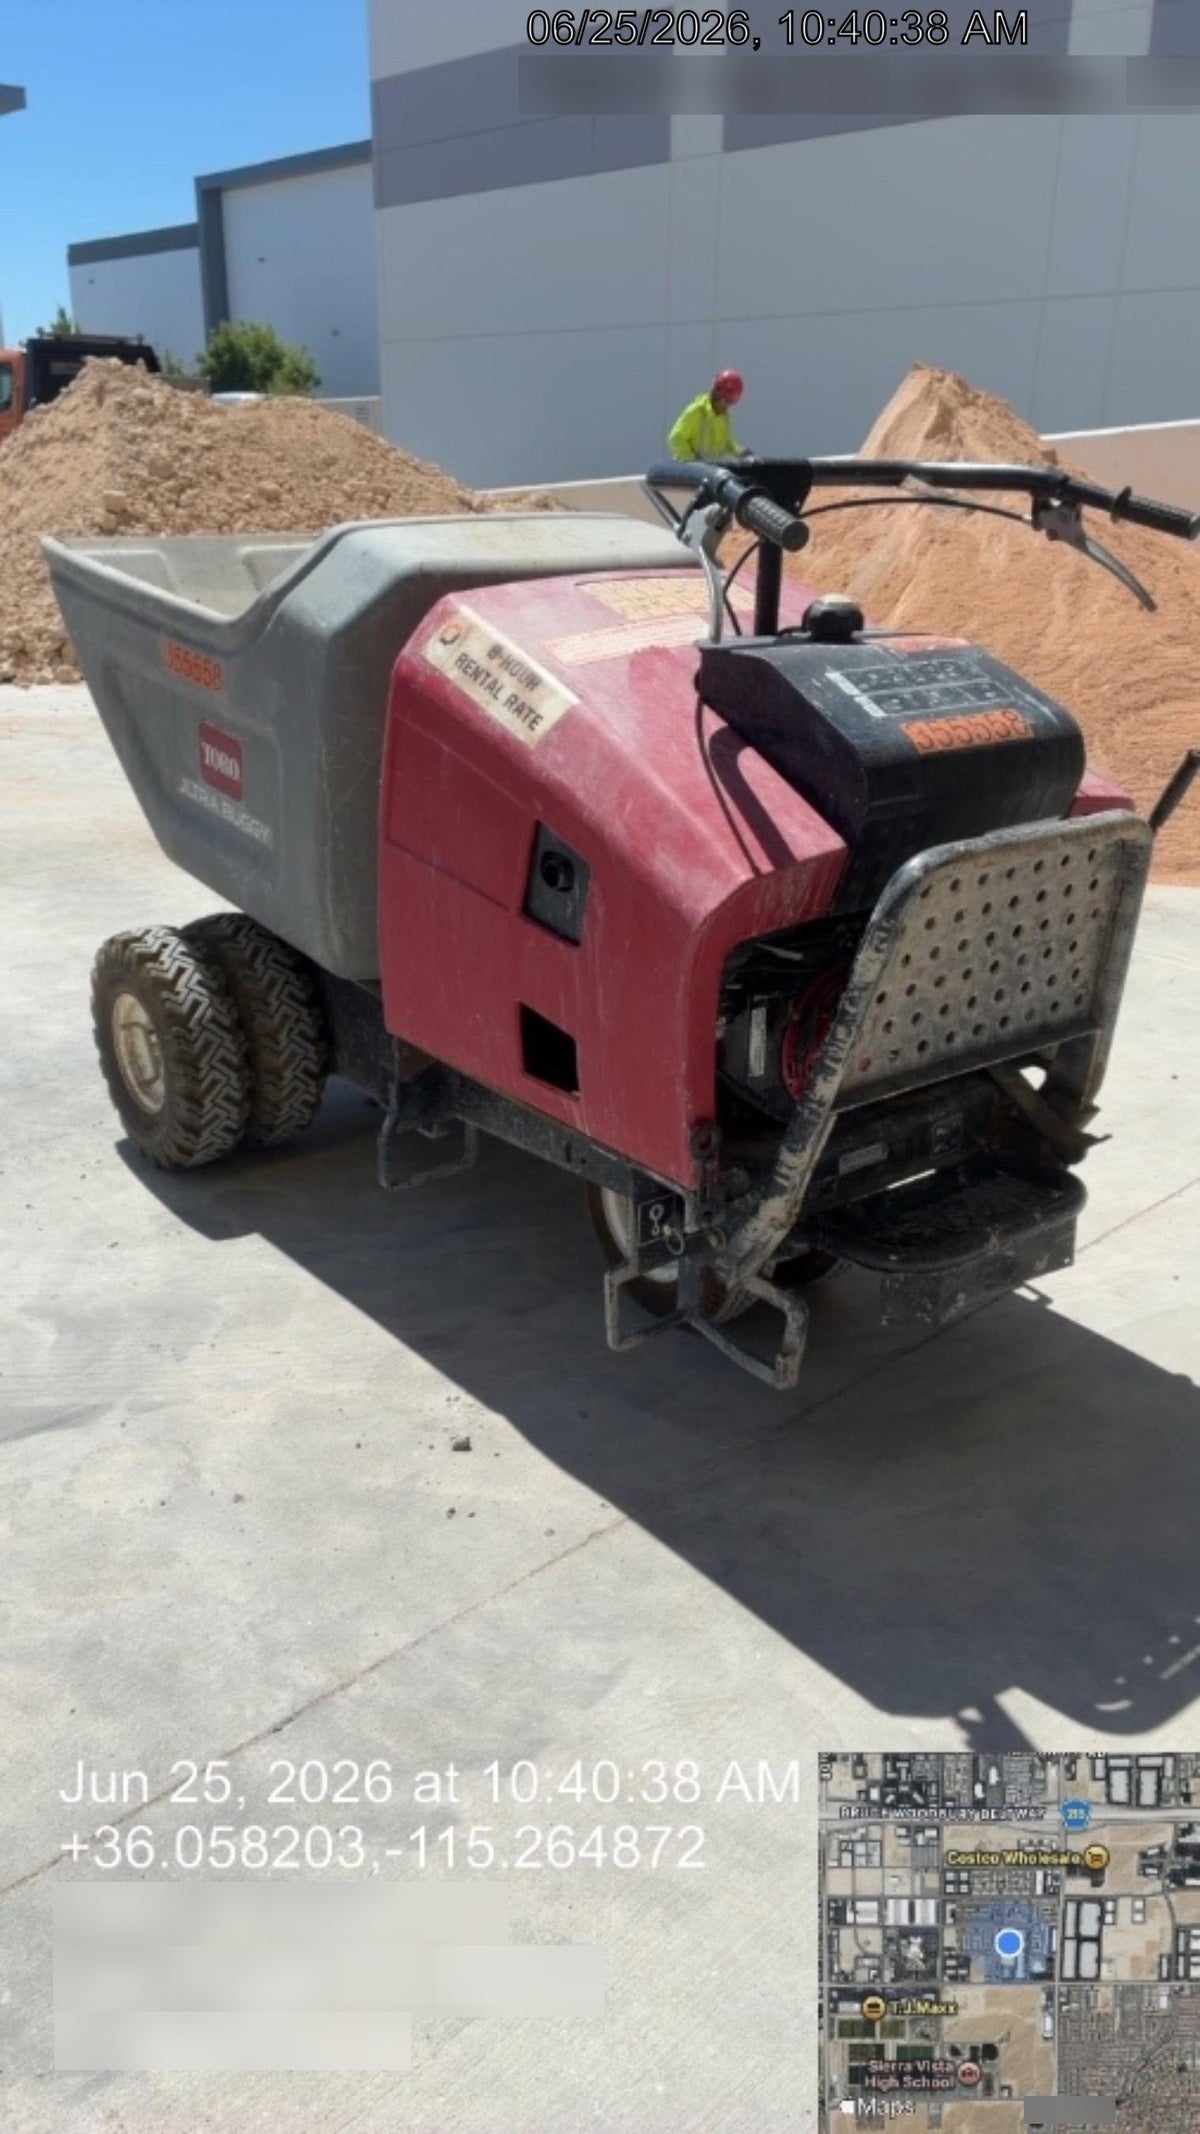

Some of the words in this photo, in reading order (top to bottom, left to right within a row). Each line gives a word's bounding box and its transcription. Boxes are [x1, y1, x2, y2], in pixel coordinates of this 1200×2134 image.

[455, 651, 503, 700] RENTAL
[503, 692, 544, 732] RATE
[201, 741, 241, 781] TORO
